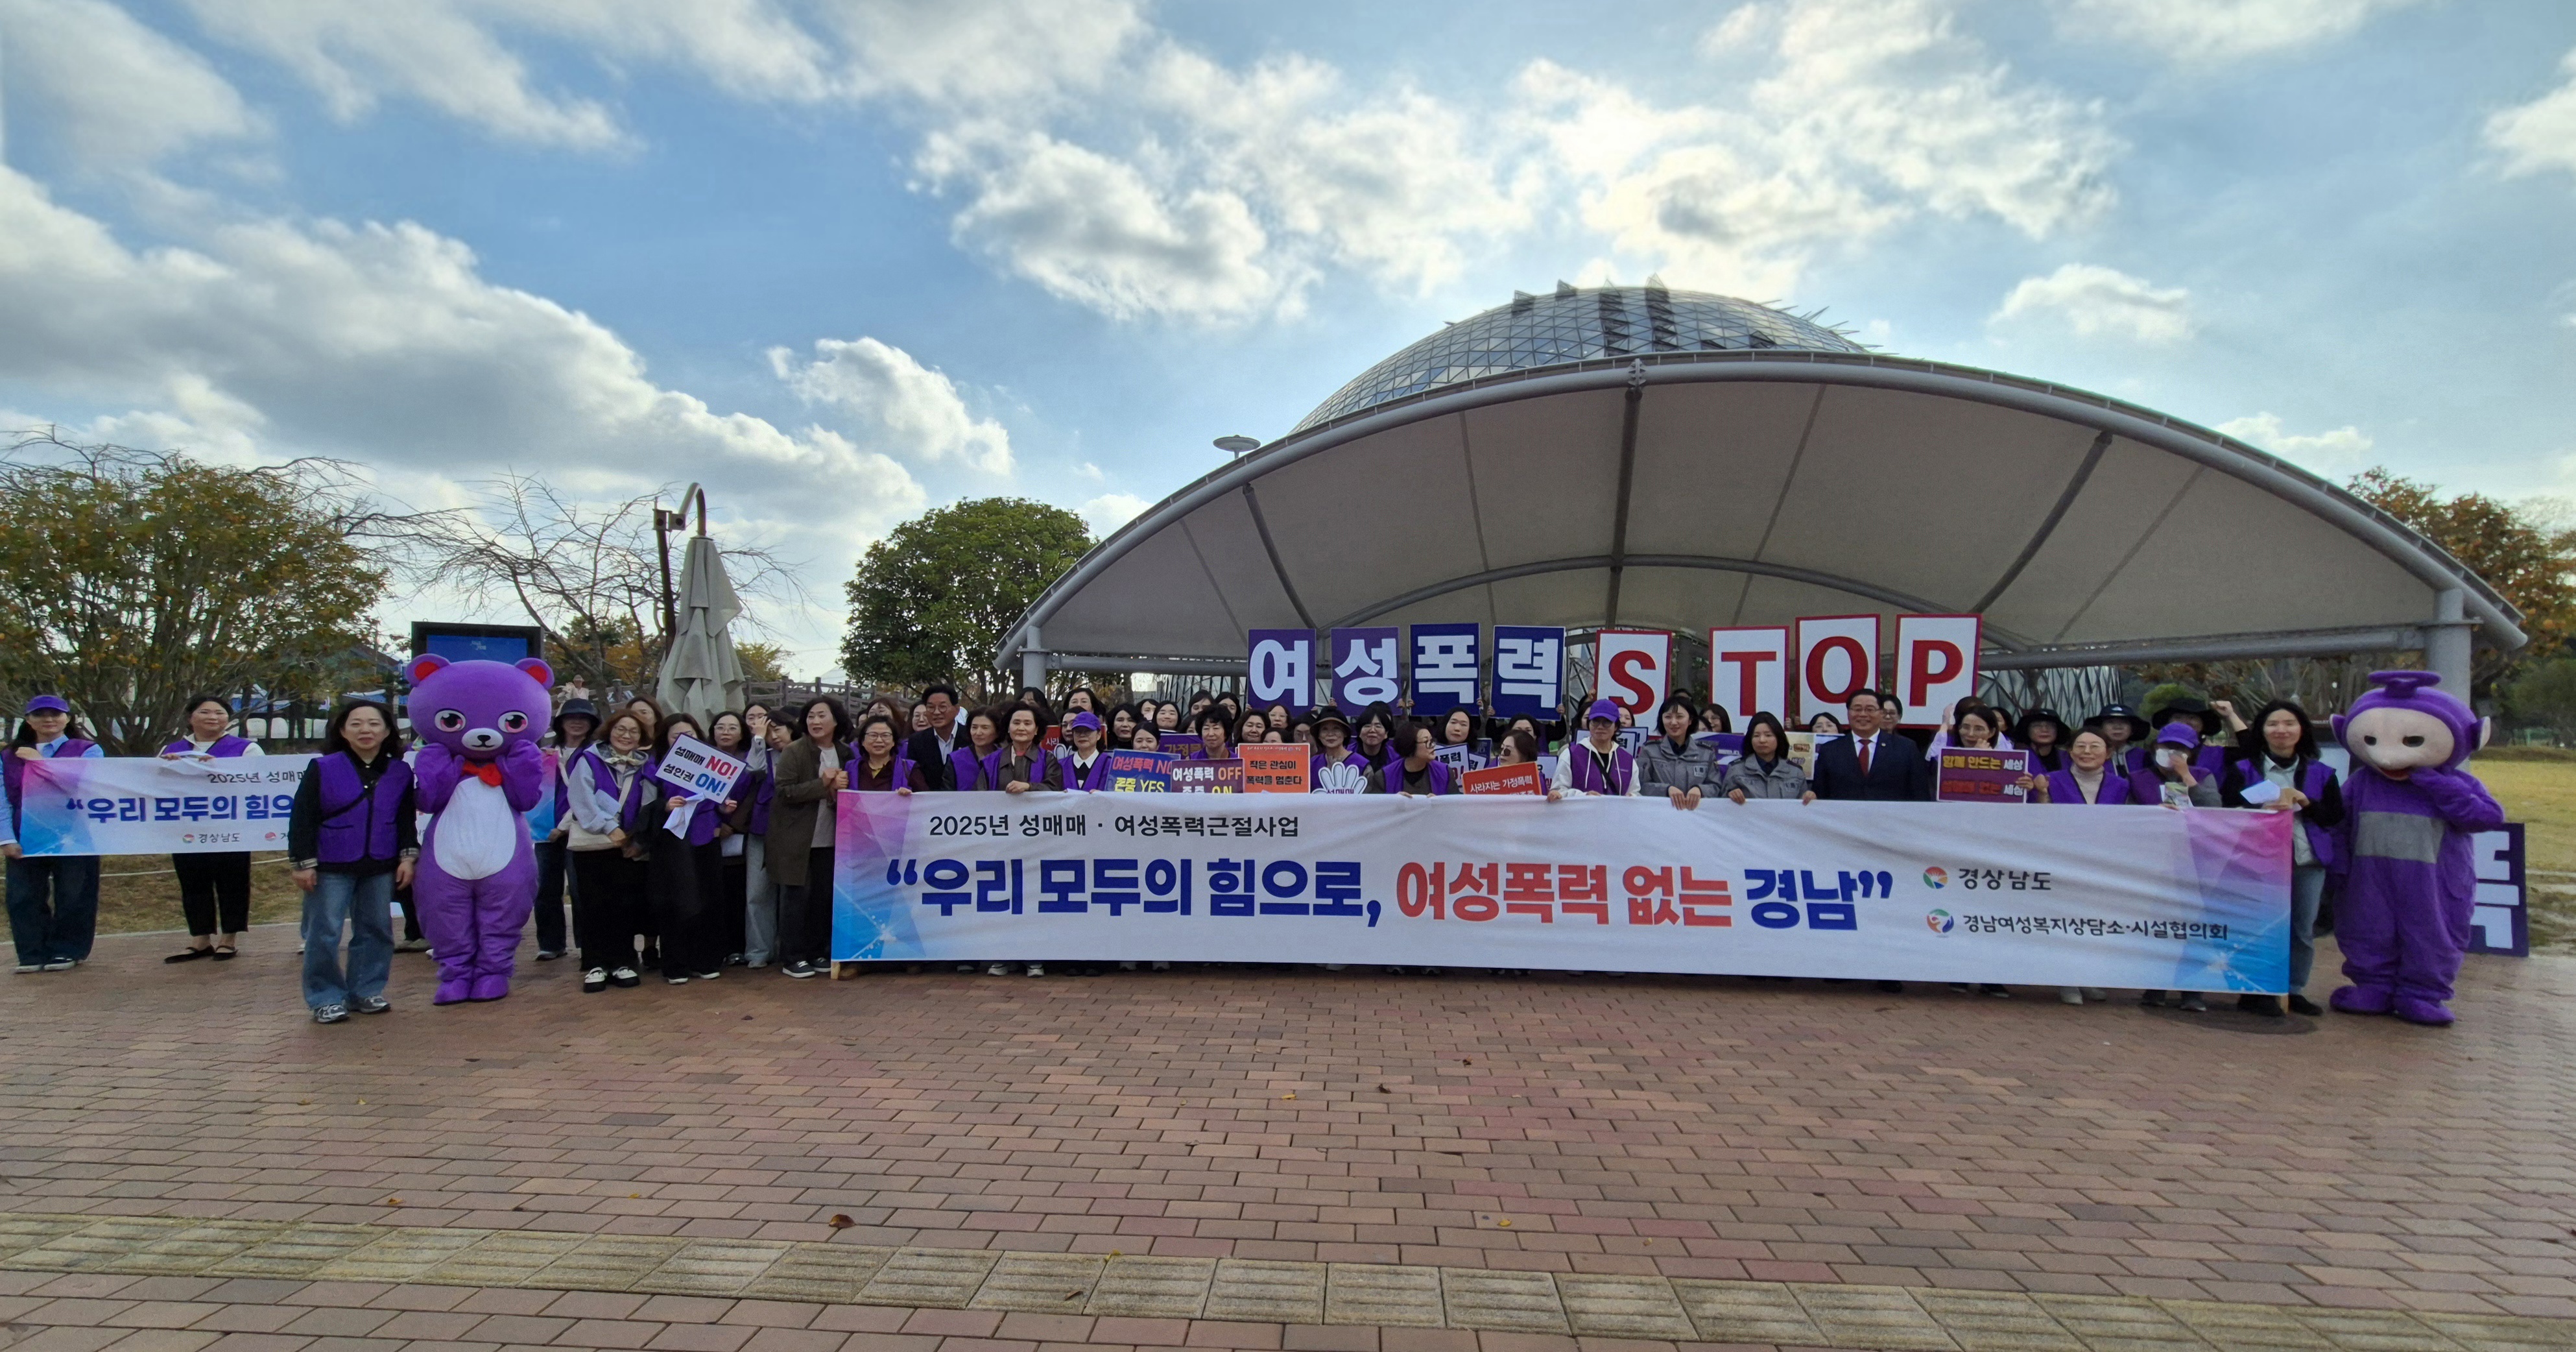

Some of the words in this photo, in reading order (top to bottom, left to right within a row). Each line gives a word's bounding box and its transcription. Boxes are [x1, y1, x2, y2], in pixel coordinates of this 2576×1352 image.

[1249, 635, 1559, 708] 여성폭력
[1608, 635, 1964, 716] STOP
[674, 746, 706, 766] 성매매
[704, 755, 738, 780] NO!
[1112, 756, 1154, 773] 여성폭력
[1270, 760, 1296, 769] 관심이
[2003, 759, 2023, 771] 세상
[208, 771, 261, 784] 2025년
[663, 764, 695, 783] 성인권
[695, 773, 727, 796] ON!
[1173, 767, 1214, 782] 여성폭력
[1218, 767, 1242, 780] OFF
[1276, 776, 1302, 785] 멈춘다
[1140, 779, 1165, 792] YES
[1470, 780, 1500, 793] 사라지는
[1502, 775, 1533, 788] 가정폭력
[154, 795, 237, 822] 모두의
[929, 815, 1009, 836] 2025년
[1019, 815, 1086, 837] 성매매
[1114, 815, 1298, 838] 여성폭력근절사업
[198, 833, 241, 843] 경상남도
[1959, 868, 2052, 891] 경상남도
[1038, 858, 1193, 917] 모두의
[1207, 858, 1382, 927] 힘으로,
[1396, 862, 1609, 924] 여성폭력
[1622, 865, 1732, 928] 없는
[1744, 869, 1894, 930] 경남”
[1963, 915, 2228, 941] 경남여성복지상담소·시설협의회
